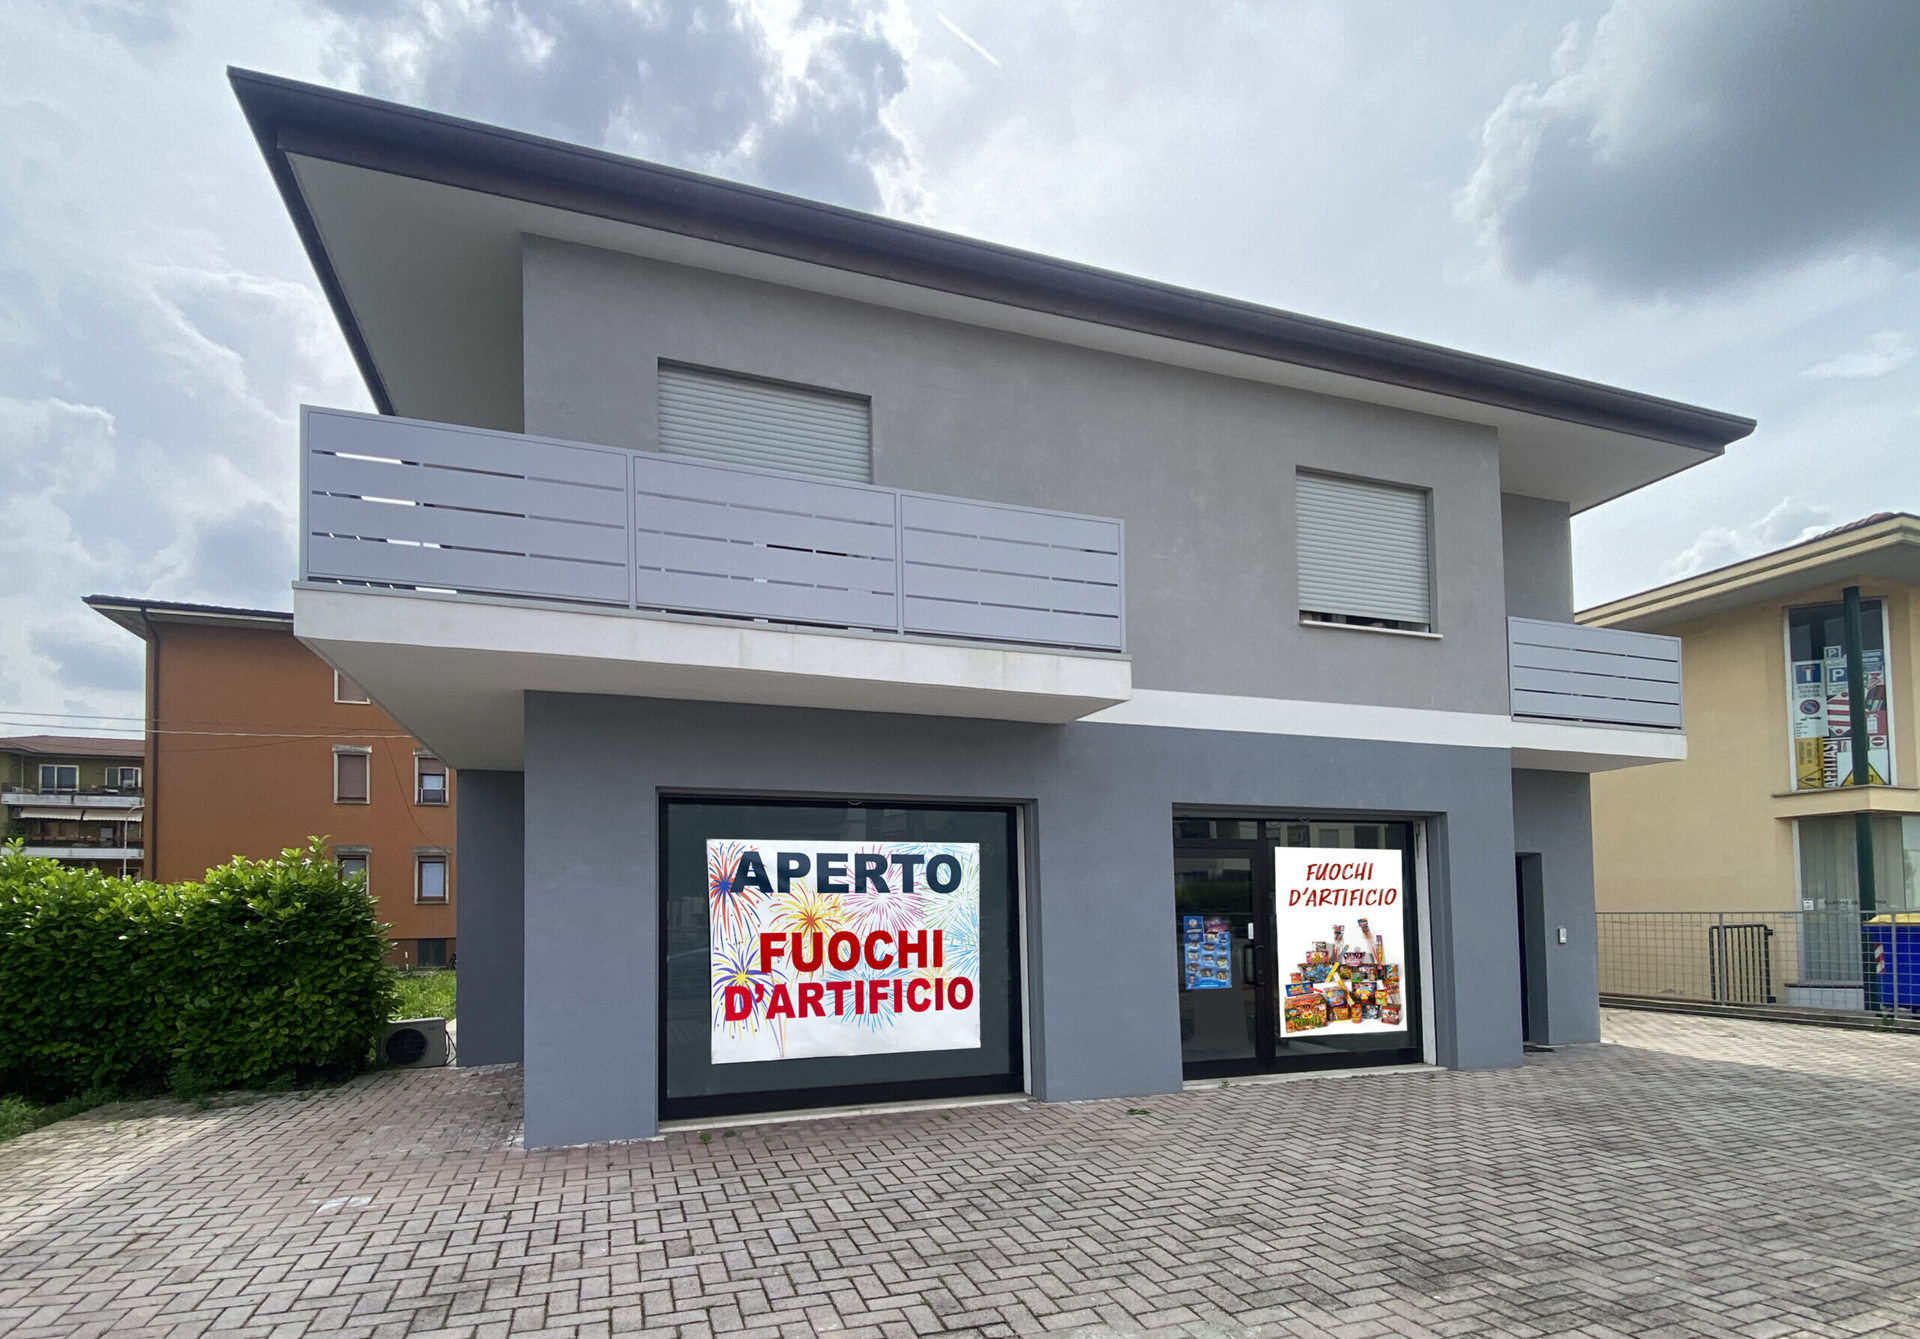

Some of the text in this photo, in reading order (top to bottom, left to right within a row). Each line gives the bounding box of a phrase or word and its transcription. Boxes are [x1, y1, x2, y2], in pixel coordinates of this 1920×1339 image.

[1828, 649, 1837, 658] P
[1832, 668, 1845, 682] P
[730, 850, 962, 894] APERTO
[1306, 861, 1374, 881] FUOCHI
[1288, 887, 1397, 908] D'ARTIFICIO
[759, 929, 944, 974] FUOCHI
[725, 976, 974, 1022] D'ARTIFICIO
